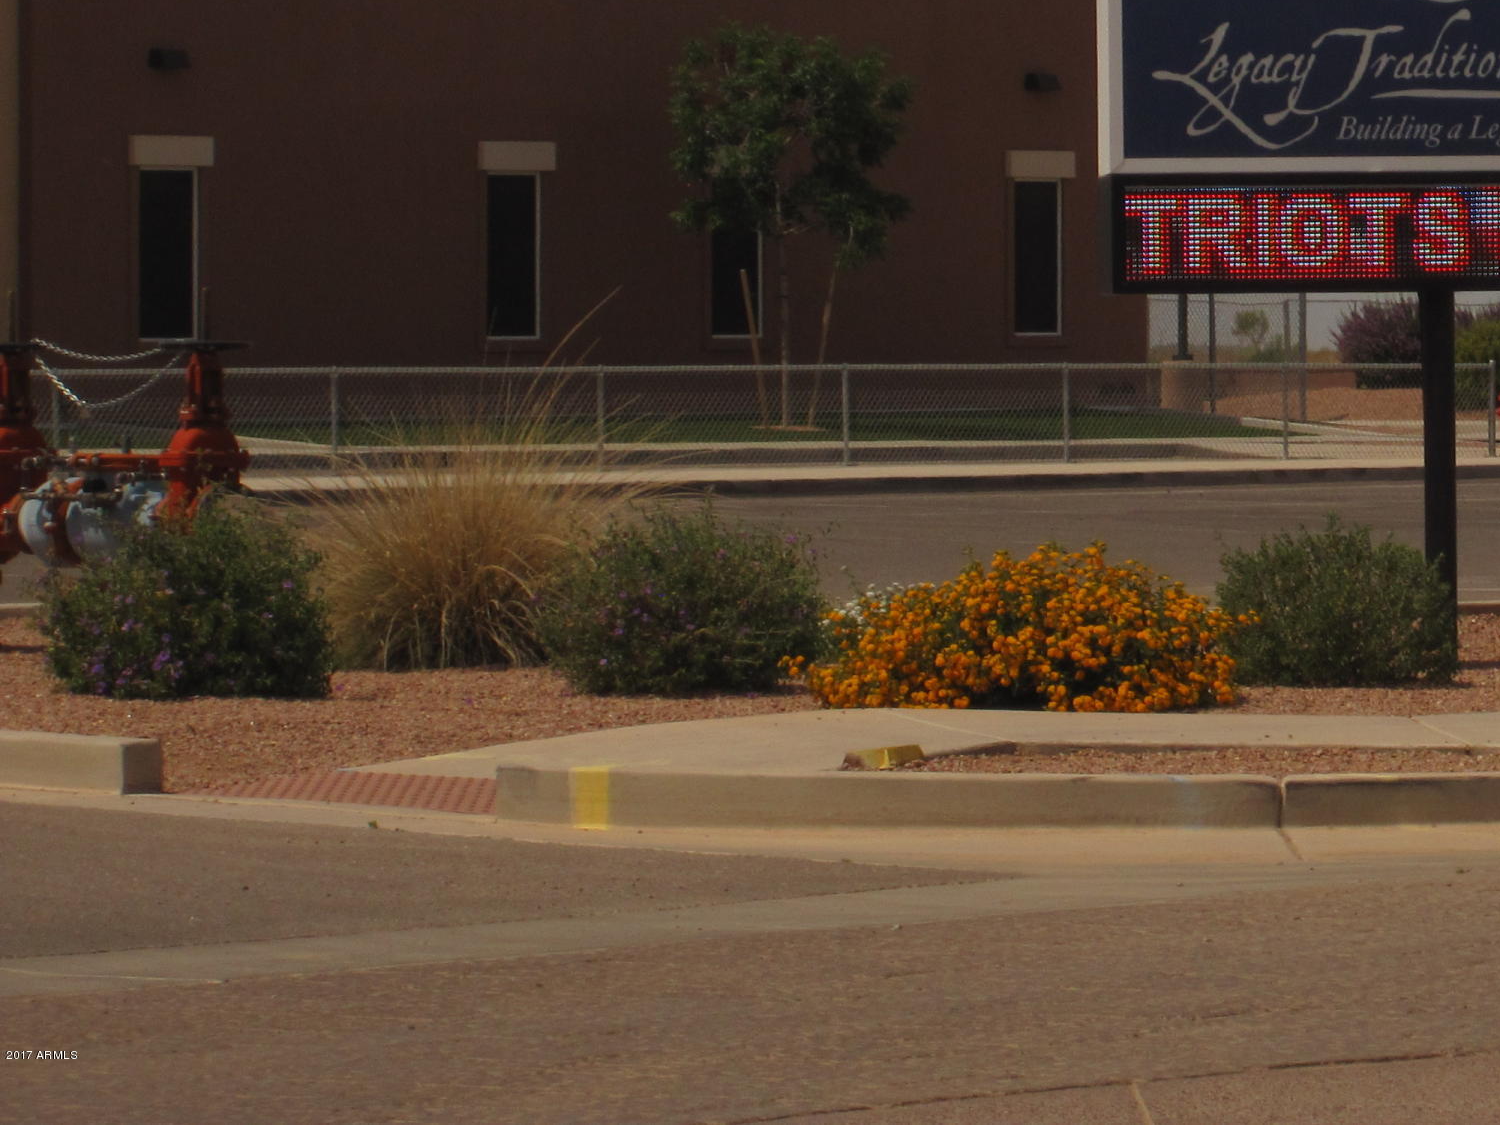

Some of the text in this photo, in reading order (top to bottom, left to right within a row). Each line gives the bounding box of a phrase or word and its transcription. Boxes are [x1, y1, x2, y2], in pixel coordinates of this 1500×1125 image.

[1152, 22, 1318, 149] Legacy
[1335, 115, 1443, 148] Building
[1447, 124, 1464, 141] a
[1124, 192, 1470, 275] TRIOTS
